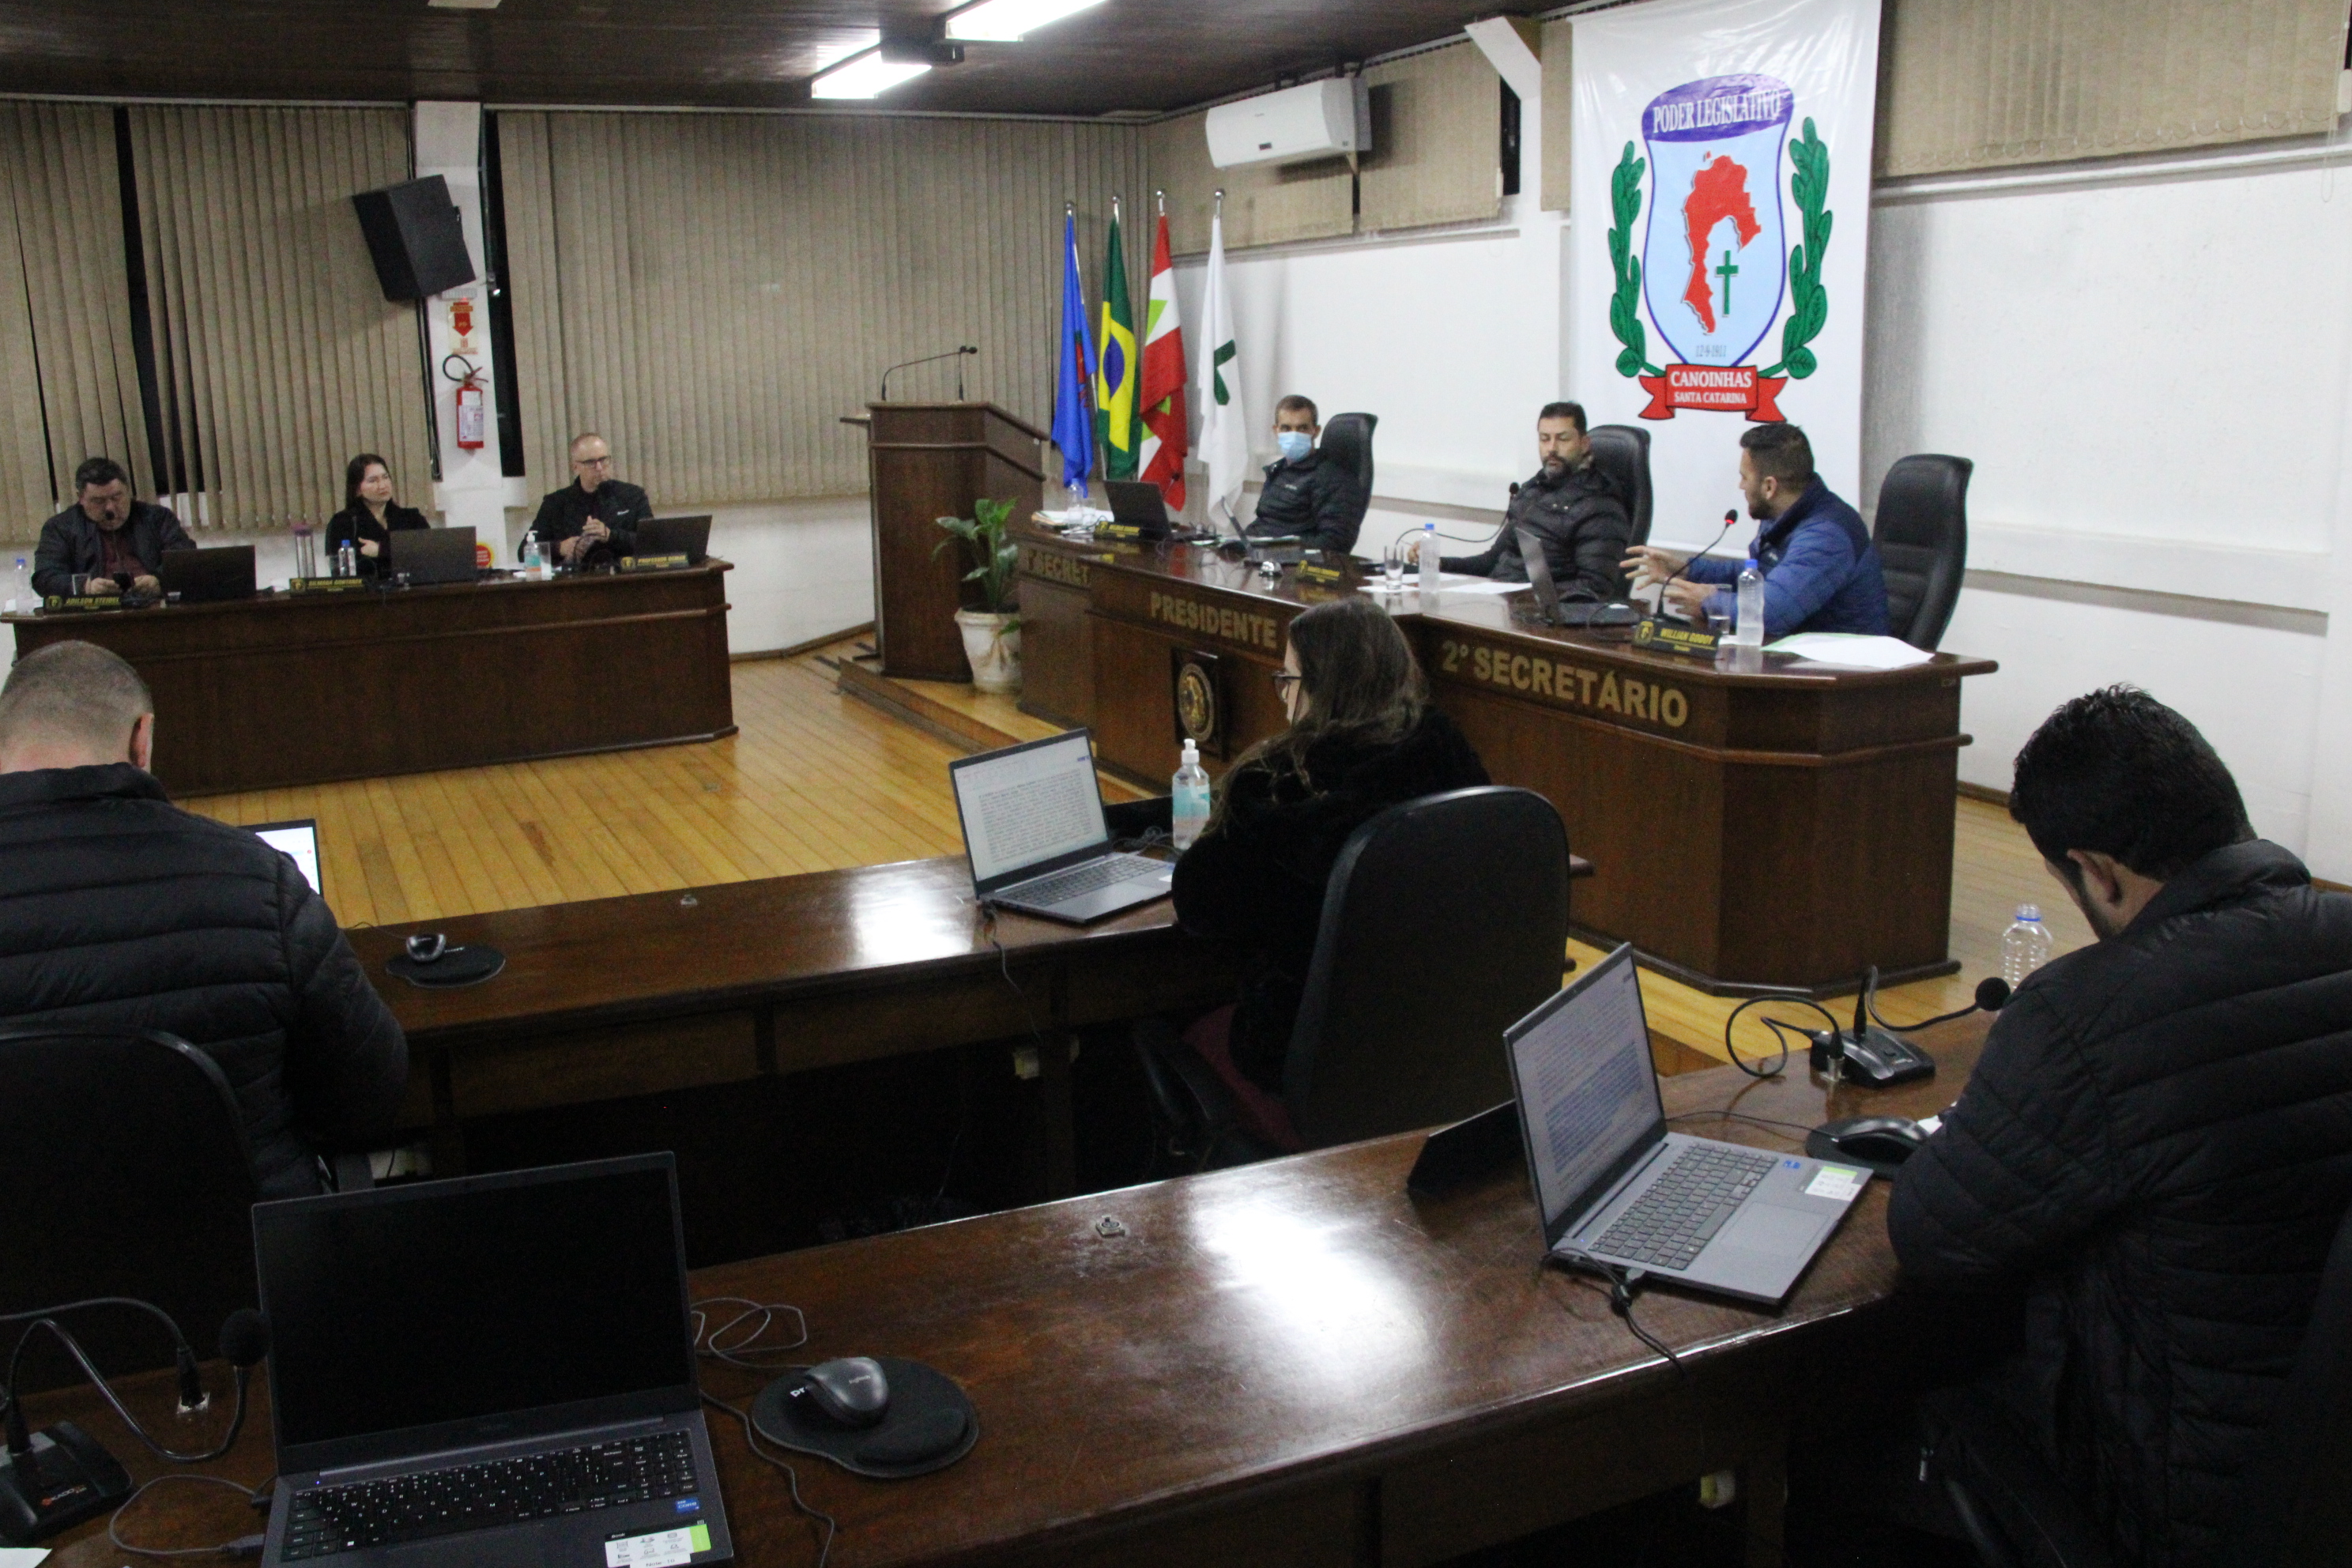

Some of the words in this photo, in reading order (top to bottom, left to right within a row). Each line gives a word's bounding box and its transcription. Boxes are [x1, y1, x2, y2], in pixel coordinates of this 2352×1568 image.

[1653, 102, 1695, 134] PODER
[1697, 89, 1781, 128] LEGISLATIVO
[1670, 371, 1753, 388] CANOINHAS
[1674, 391, 1702, 402] SANTA
[1702, 392, 1747, 404] CATARINA
[1150, 591, 1277, 649] PRESIDENTE
[1473, 646, 1689, 728] SECRETÁRIO
